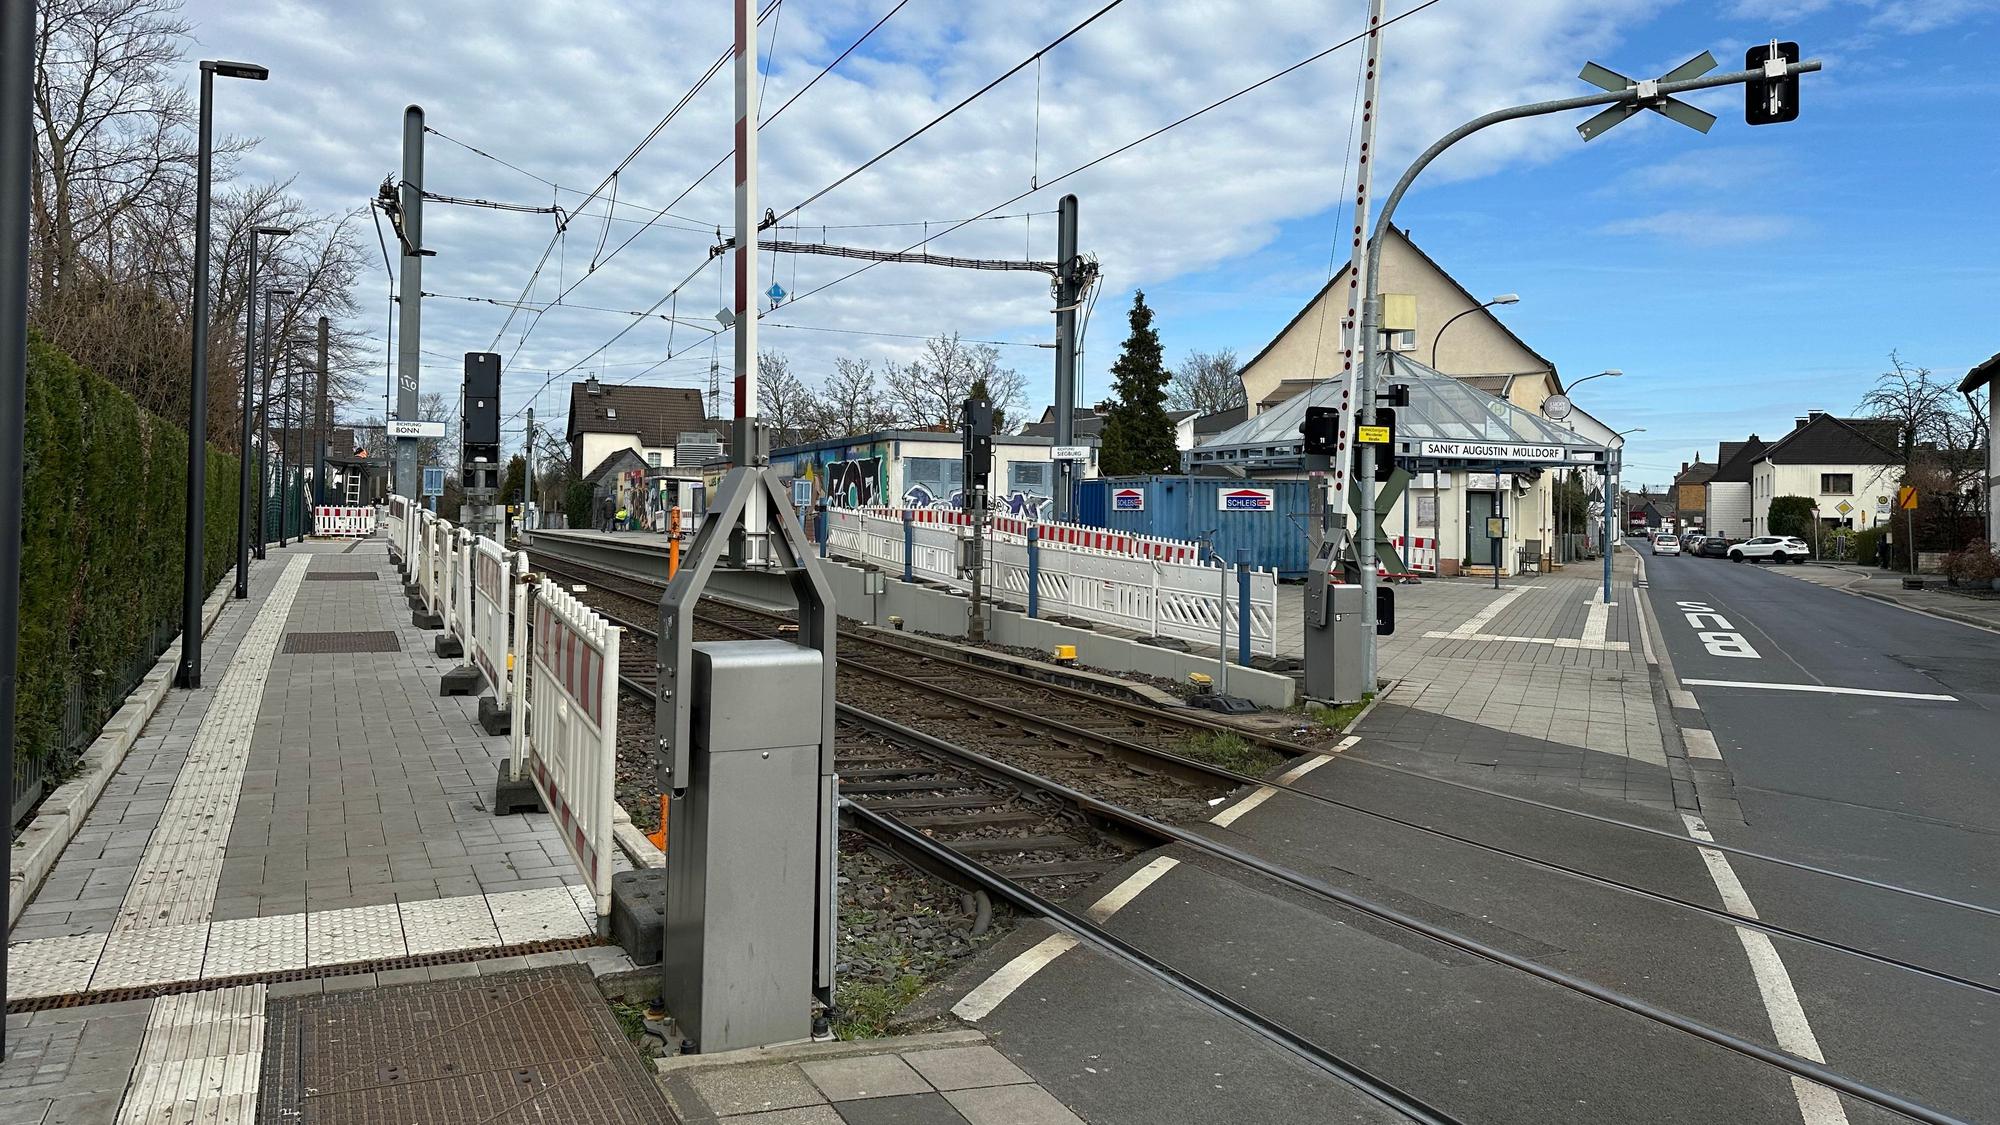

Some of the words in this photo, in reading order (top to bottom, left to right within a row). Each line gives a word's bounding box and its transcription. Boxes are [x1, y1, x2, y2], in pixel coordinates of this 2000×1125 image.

[1428, 443, 1459, 455] SANKT
[1462, 445, 1508, 457] AUGUSTIN
[1512, 447, 1559, 459] MÜLLDORF
[1227, 499, 1257, 507] SCHLEIS
[1675, 601, 1762, 659] BUS
